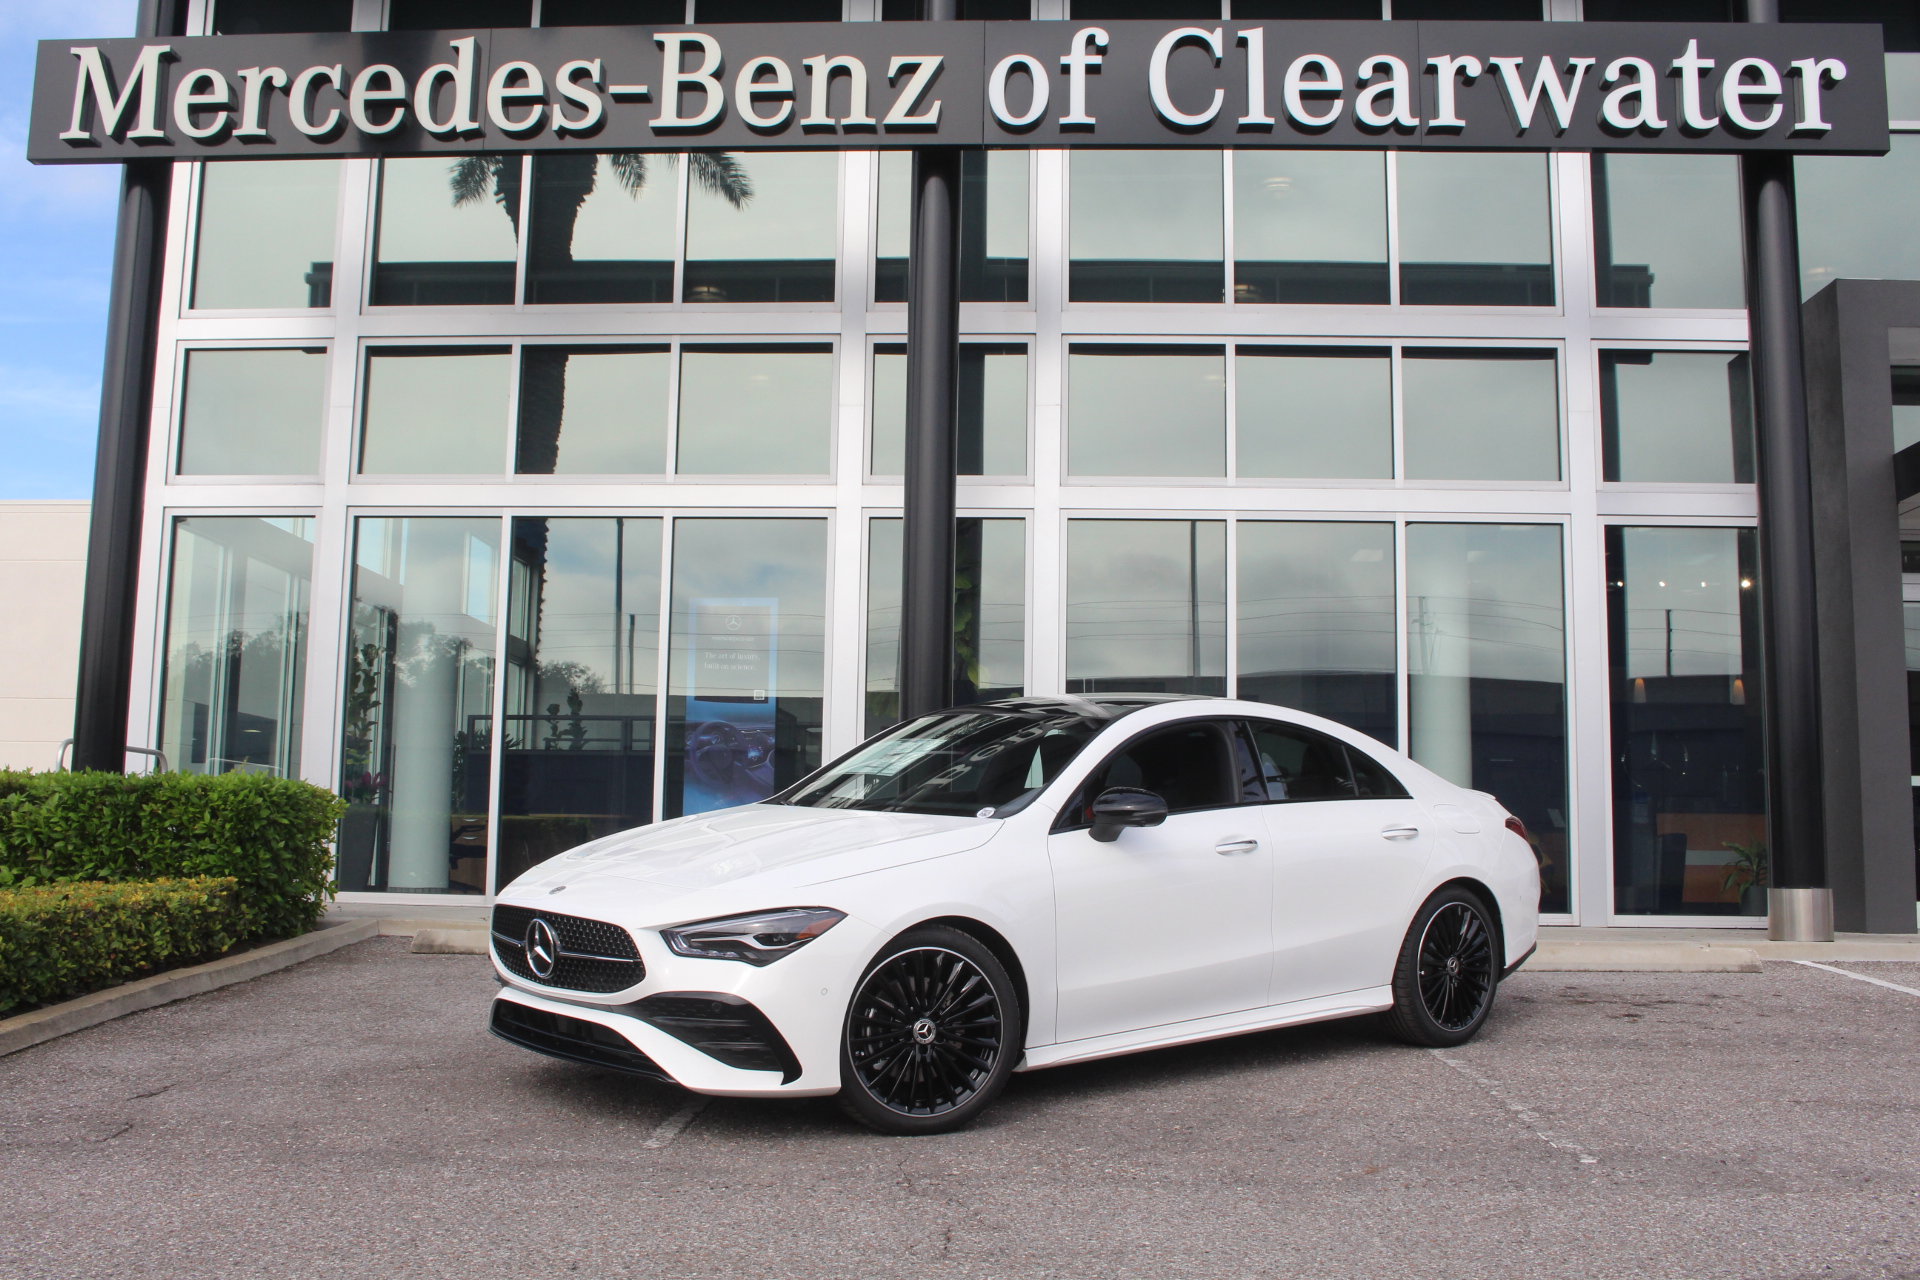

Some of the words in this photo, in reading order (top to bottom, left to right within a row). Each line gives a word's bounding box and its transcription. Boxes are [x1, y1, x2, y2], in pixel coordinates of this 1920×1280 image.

[59, 32, 944, 140] Mercedes-Benz
[989, 28, 1109, 125] of
[1149, 27, 1847, 130] Clearwater
